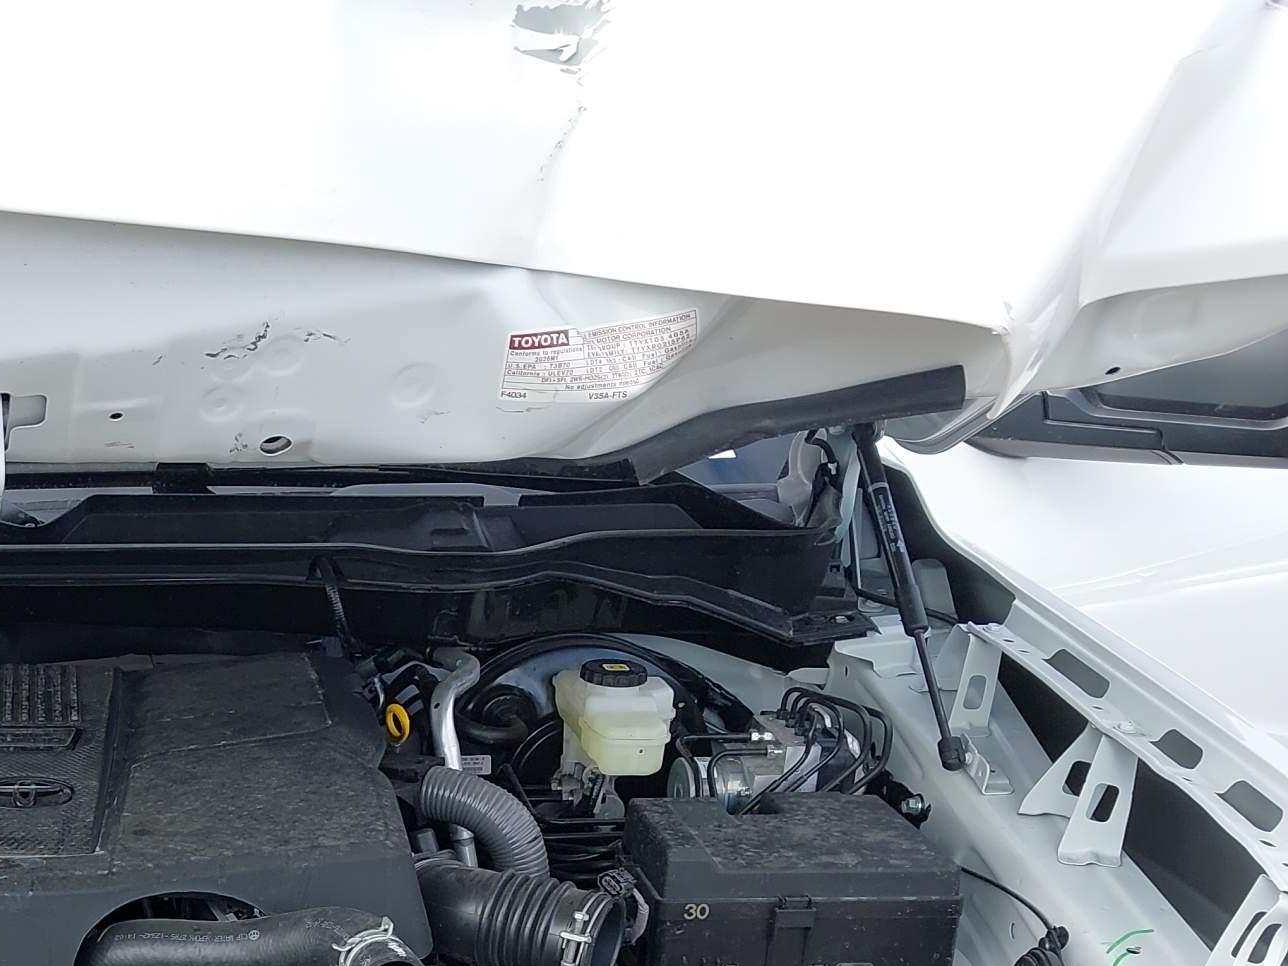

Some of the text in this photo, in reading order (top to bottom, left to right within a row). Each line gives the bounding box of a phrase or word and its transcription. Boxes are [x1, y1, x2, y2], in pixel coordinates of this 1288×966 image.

[512, 333, 568, 348] TOYOTA
[588, 390, 628, 400] V35A-FTS
[683, 903, 710, 920] 30
